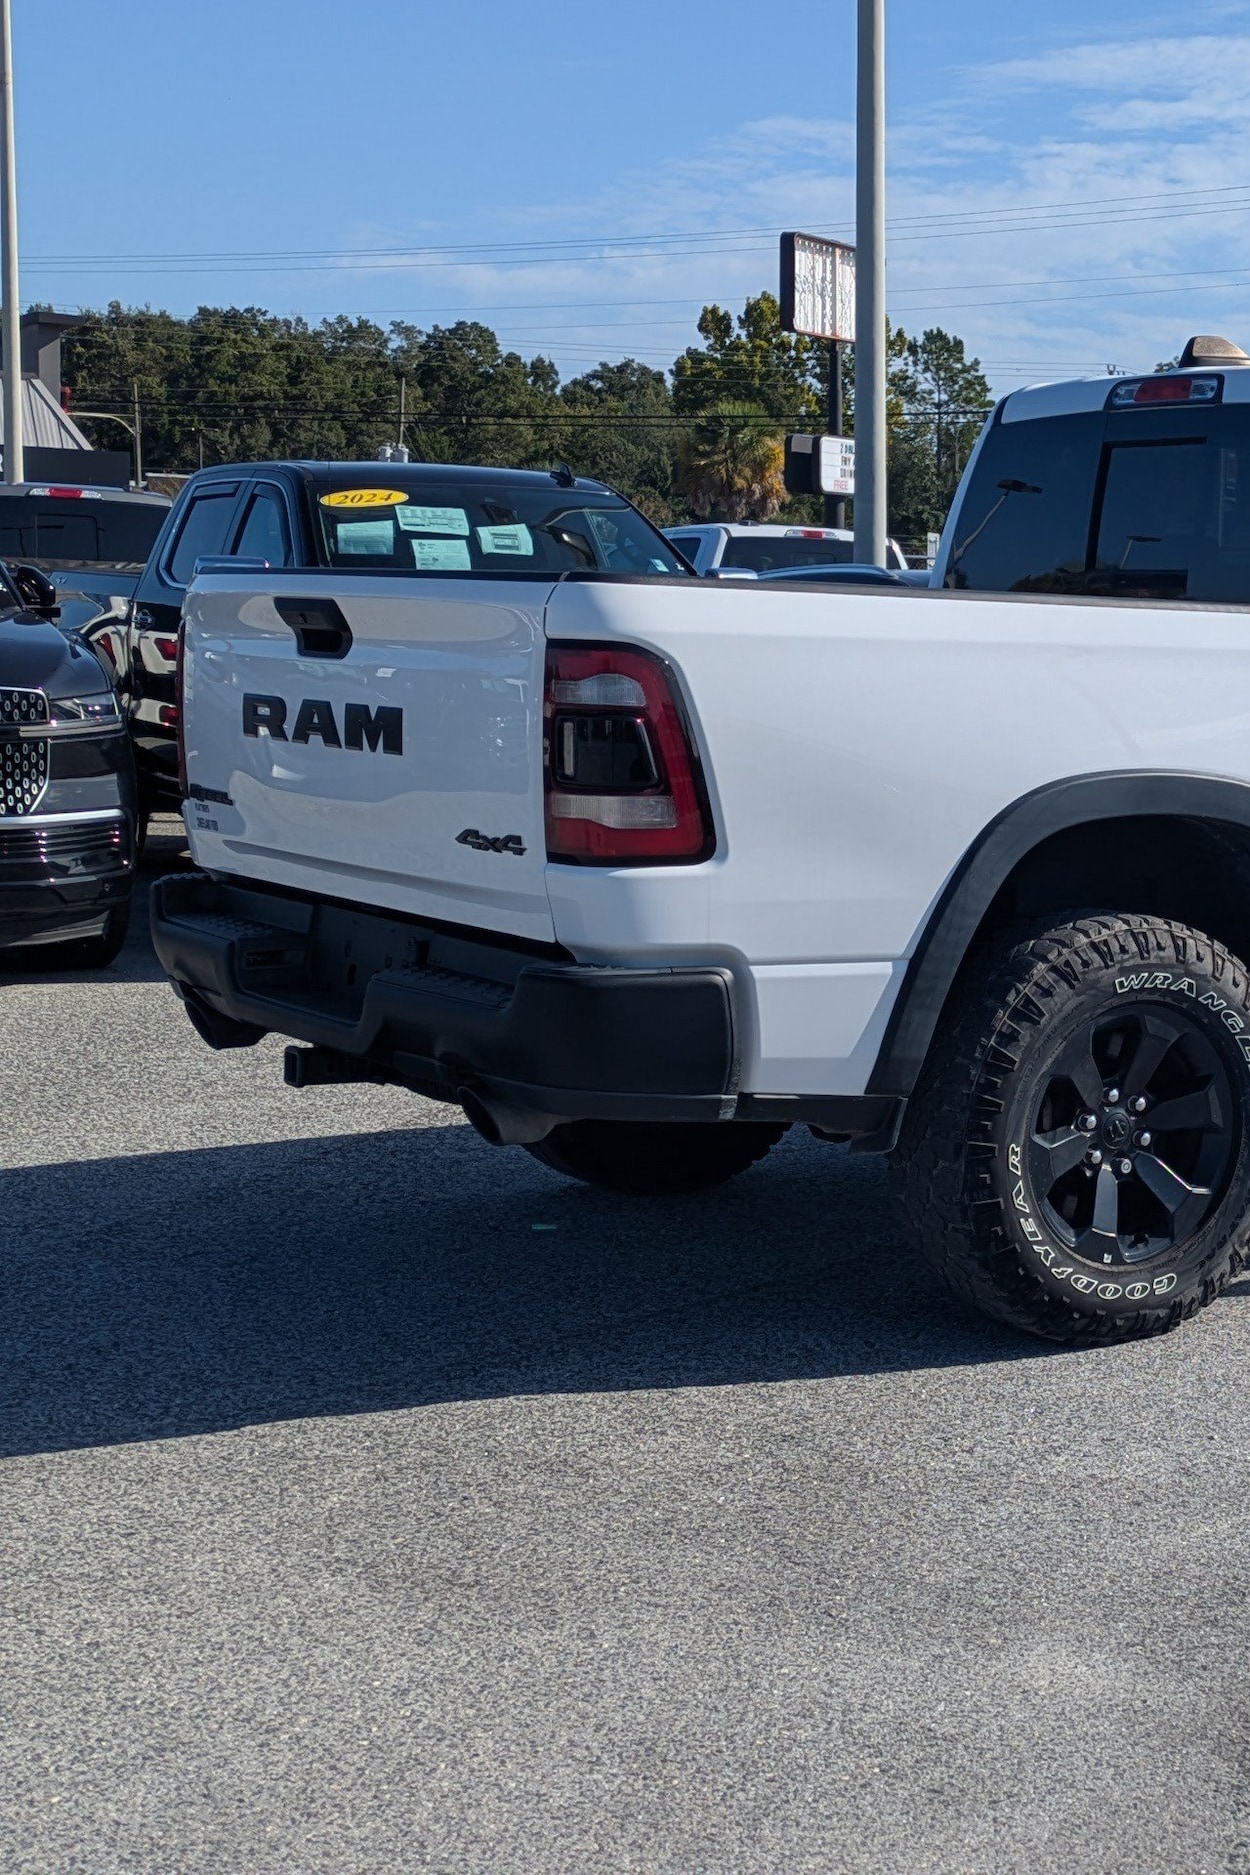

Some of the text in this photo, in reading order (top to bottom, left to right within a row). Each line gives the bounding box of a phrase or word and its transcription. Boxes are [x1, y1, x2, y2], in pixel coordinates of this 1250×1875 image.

[338, 491, 394, 505] 2024
[834, 479, 848, 490] FREE
[242, 692, 404, 756] RAM
[454, 828, 528, 856] 4x4
[1007, 1142, 1178, 1300] GOODYEAR
